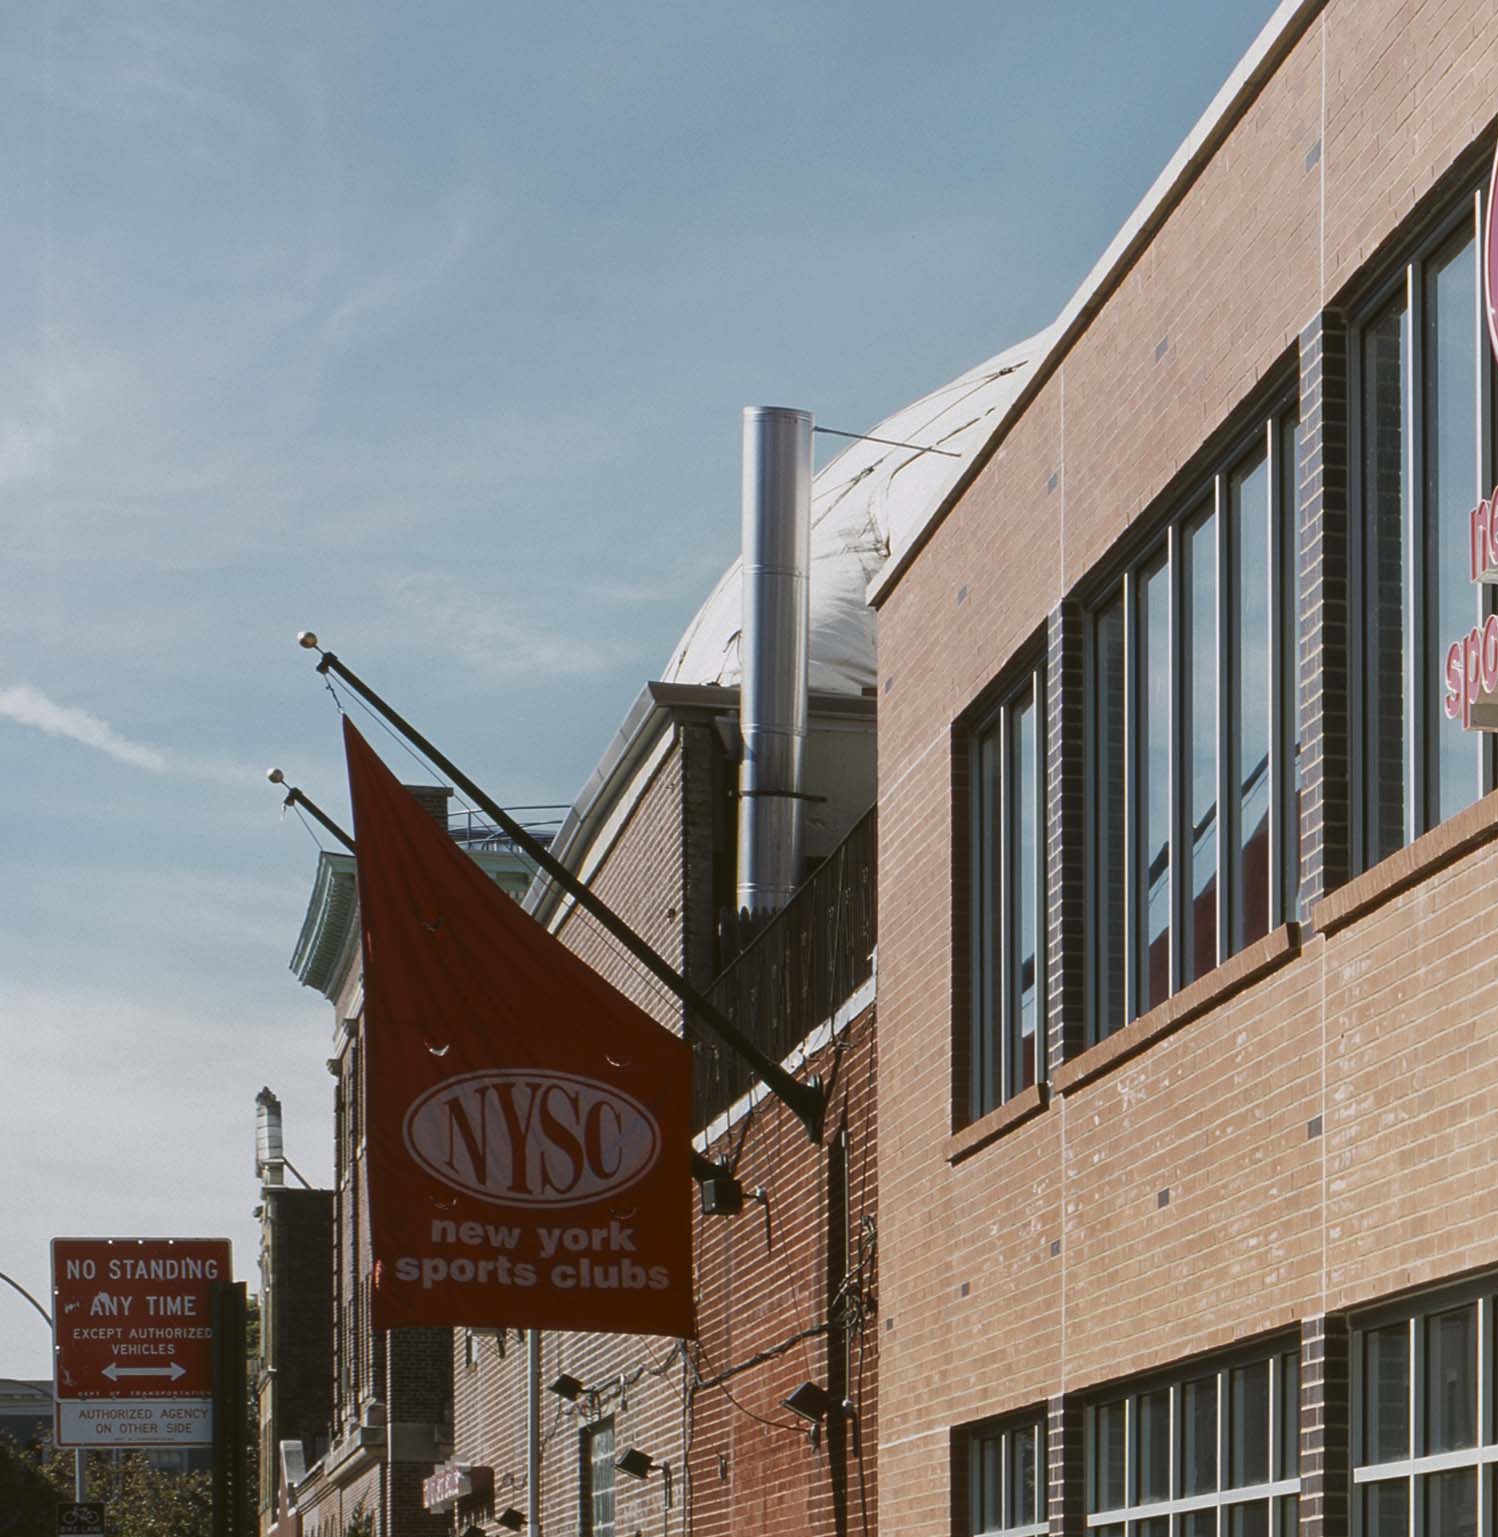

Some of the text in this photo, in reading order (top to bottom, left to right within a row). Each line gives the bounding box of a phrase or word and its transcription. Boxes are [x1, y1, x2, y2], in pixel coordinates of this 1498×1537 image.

[444, 1081, 624, 1196] NYSC
[430, 1219, 636, 1258] new york
[66, 1258, 218, 1280] NO STANDING
[395, 1255, 671, 1289] sports clubs
[90, 1295, 197, 1316] ANY TIME
[73, 1327, 213, 1340] EXCEPT AUTHORIZED
[111, 1343, 176, 1355] VEHICLES
[79, 1408, 209, 1420] AUTHORIZED AGENCY
[95, 1422, 193, 1435] ON OTHER SIDE
